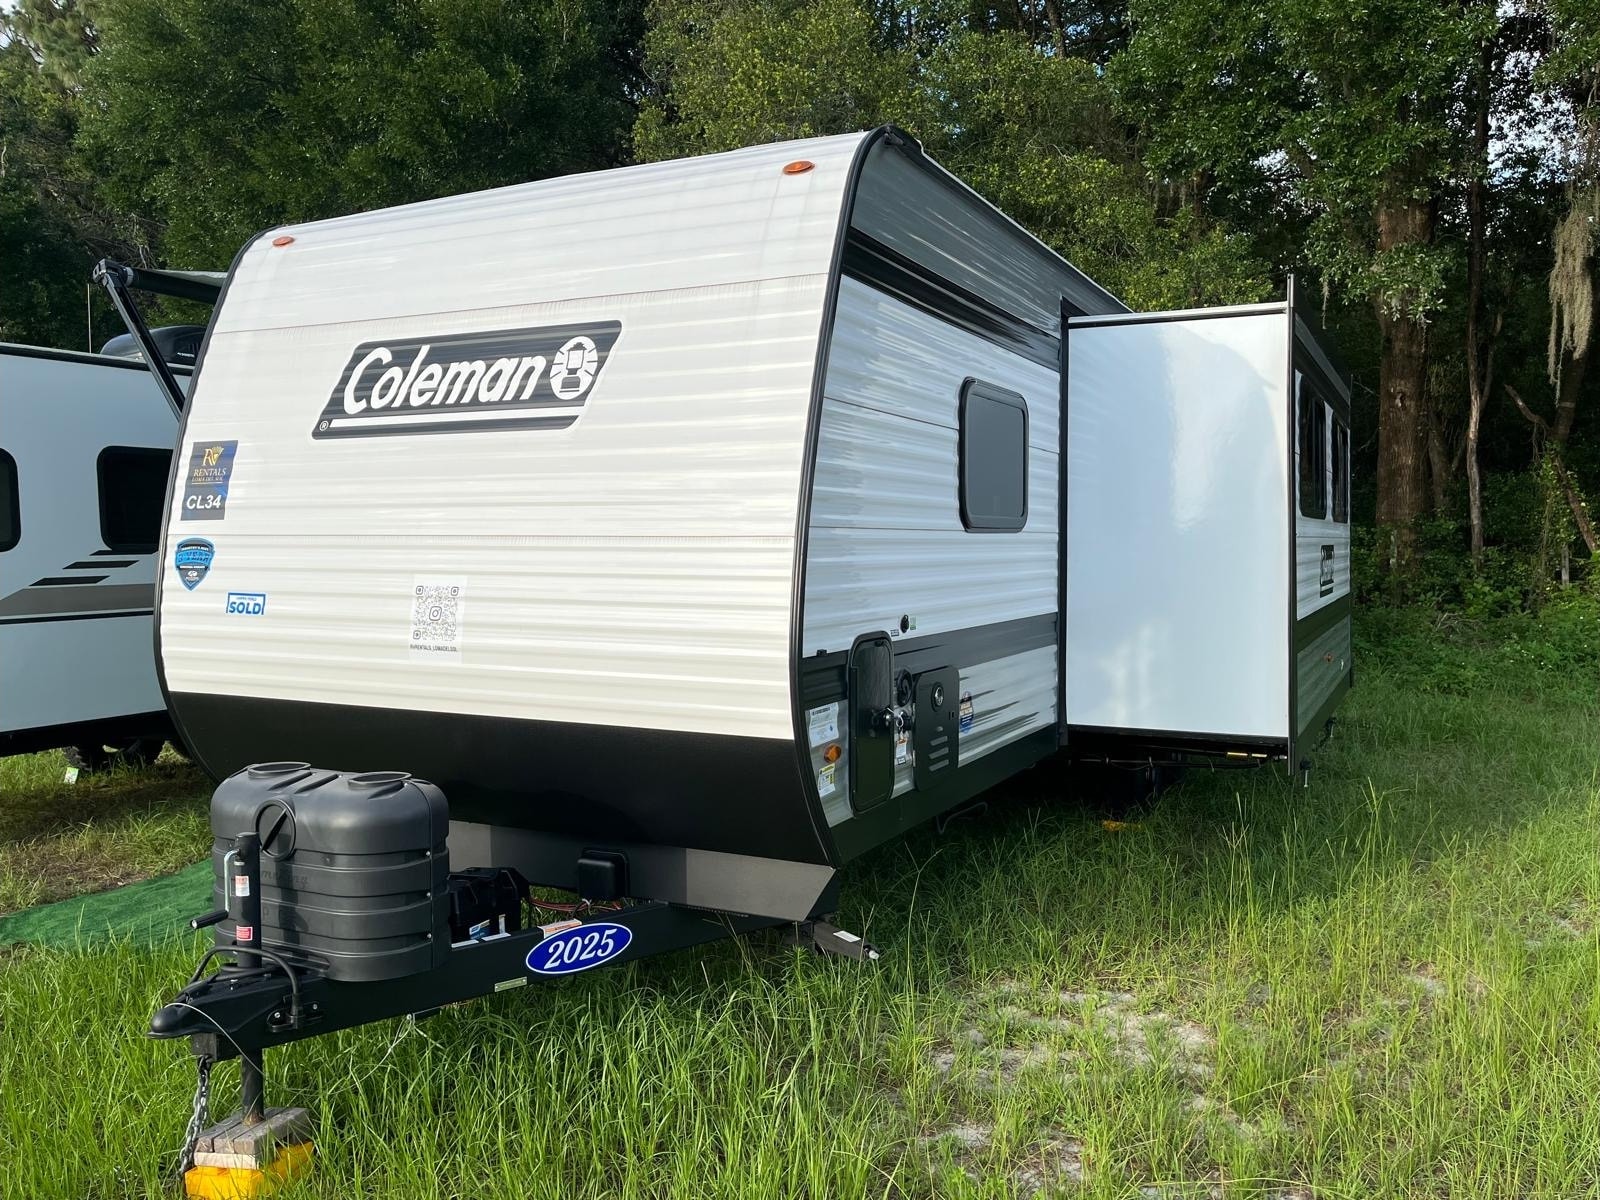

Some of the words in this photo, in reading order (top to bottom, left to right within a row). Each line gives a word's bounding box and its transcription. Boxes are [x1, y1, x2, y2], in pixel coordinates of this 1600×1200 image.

[343, 344, 546, 414] Coleman
[194, 467, 227, 477] RENTALS
[186, 495, 222, 509] CL34
[229, 602, 261, 614] SOLD
[543, 928, 617, 970] 2025
